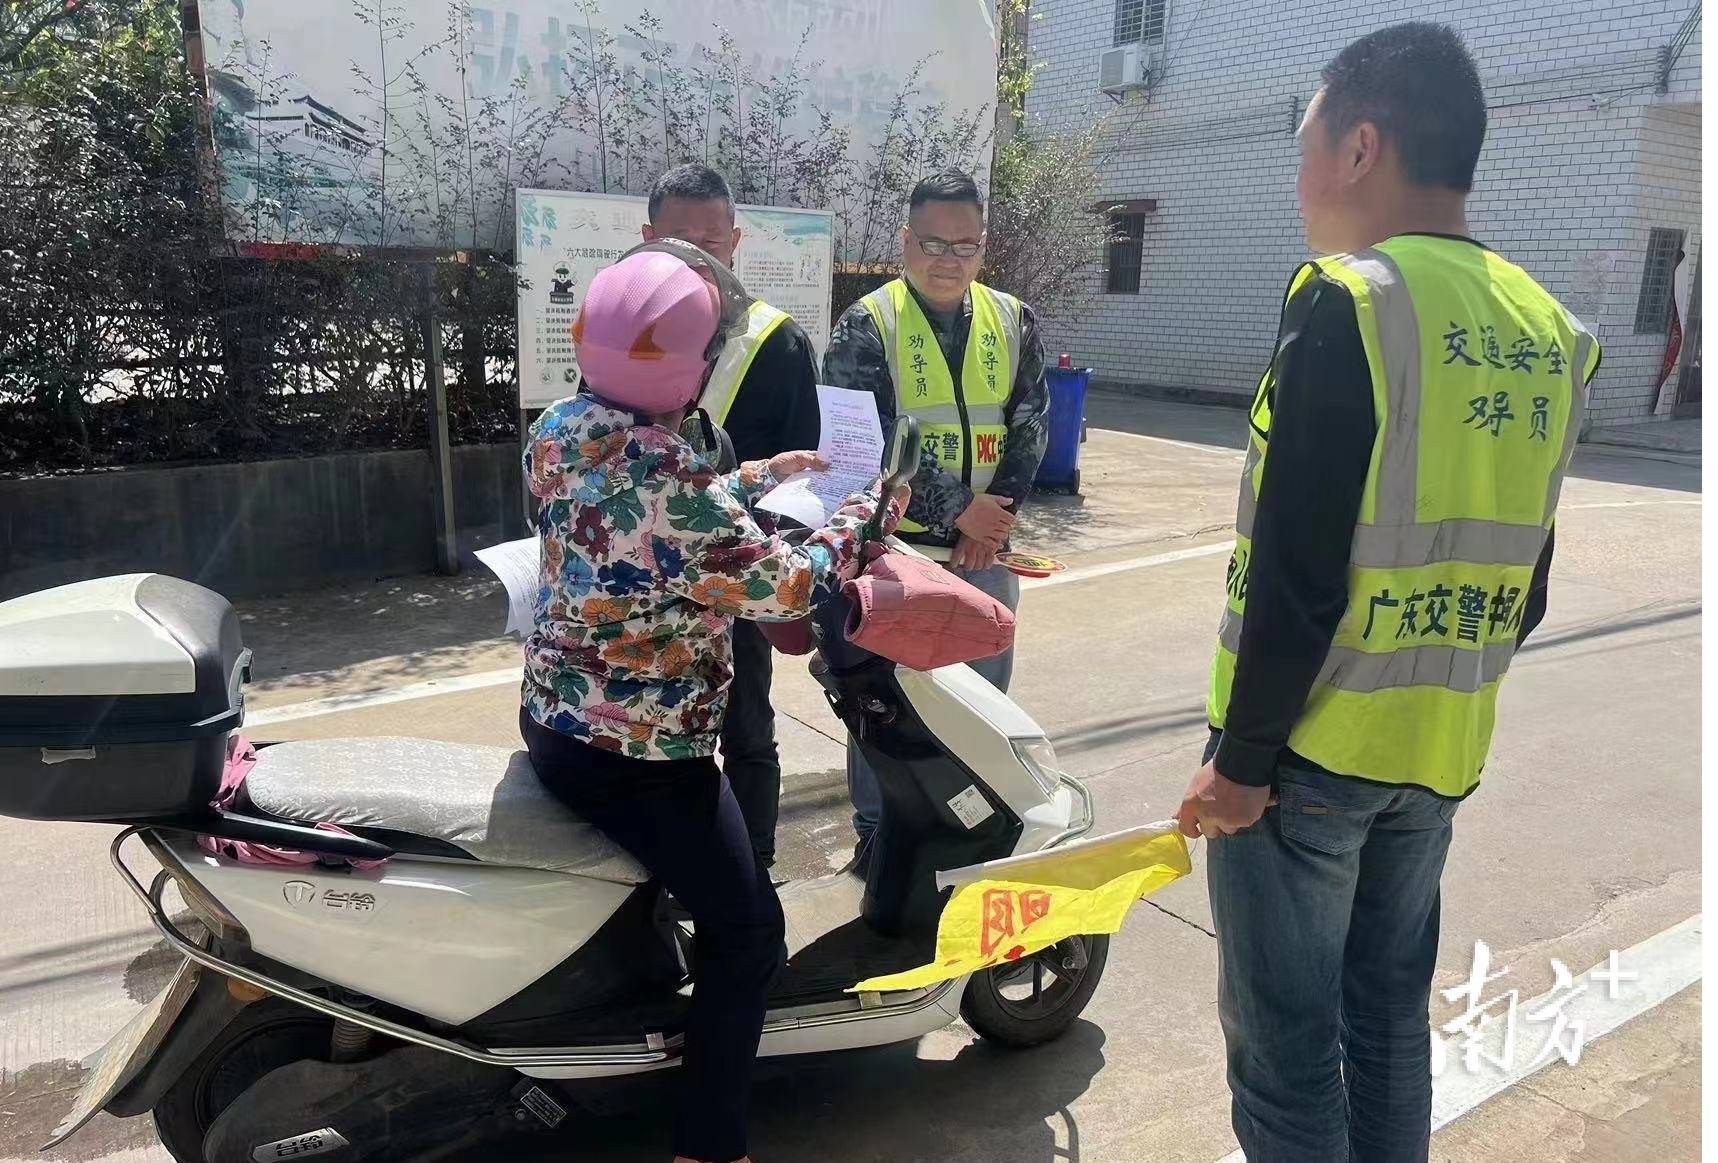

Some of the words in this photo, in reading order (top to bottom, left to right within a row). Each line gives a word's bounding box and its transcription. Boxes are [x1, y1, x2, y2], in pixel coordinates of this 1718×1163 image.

[909, 333, 928, 398] 劝导员
[981, 331, 999, 394] 劝导员
[1443, 320, 1568, 375] 交通安全
